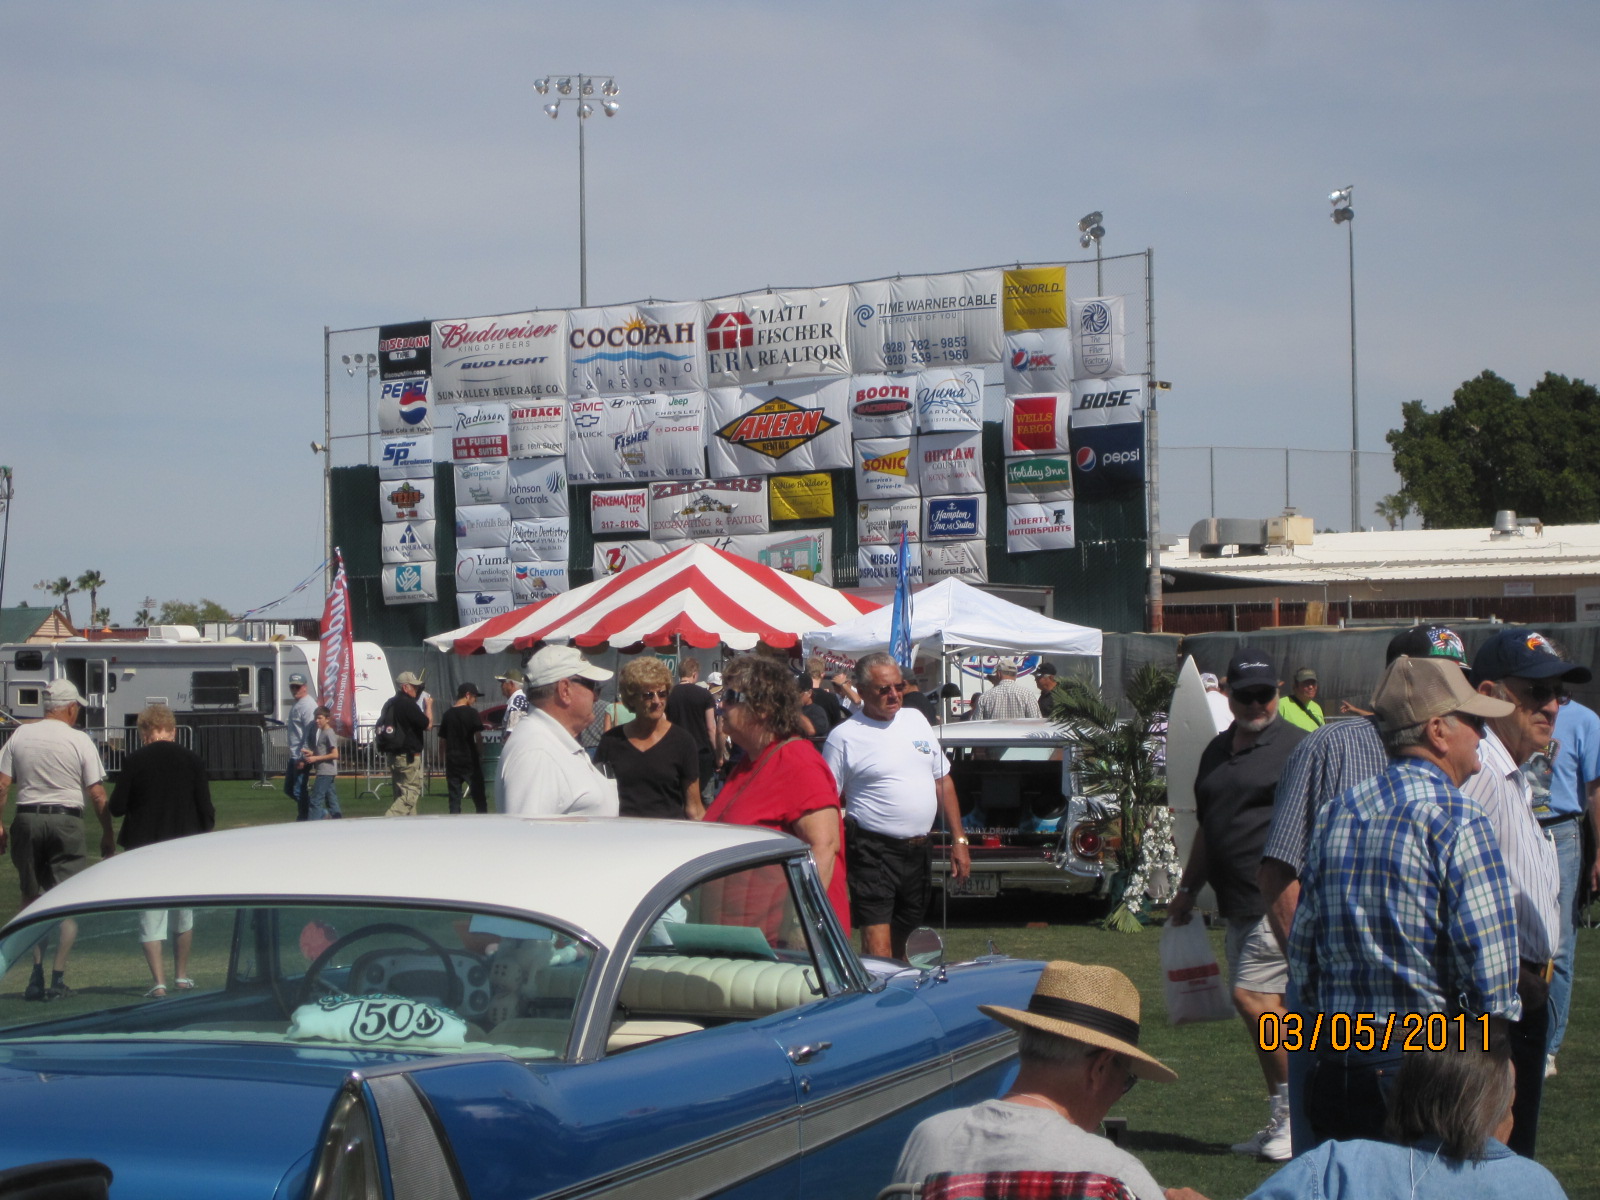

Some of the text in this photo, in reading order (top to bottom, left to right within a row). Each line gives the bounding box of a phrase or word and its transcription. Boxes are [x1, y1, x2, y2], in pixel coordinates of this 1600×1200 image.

[1022, 283, 1060, 294] WORLD
[877, 294, 997, 315] TIME WARNER CABLE
[758, 305, 808, 325] MATT
[894, 316, 923, 324] POWER
[440, 320, 558, 349] Budweiser
[569, 322, 695, 349] COCOPAH
[757, 323, 833, 346] FISCHER
[1090, 336, 1102, 344] The
[380, 335, 429, 351] DISCOUNT
[458, 341, 531, 353] KING OF BEERS
[883, 341, 906, 354] (928)
[758, 344, 842, 365] REALTOR
[883, 353, 907, 366] (928)
[1028, 353, 1057, 367] MAX
[1085, 357, 1109, 365] Factory
[460, 356, 549, 370] BUD LIGHT
[709, 352, 756, 374] ERA
[572, 362, 692, 378] CASINO
[381, 380, 429, 399] PEPSI
[586, 376, 678, 390] & RESORT
[437, 384, 559, 401] SUN VALLEY BEVERAGE CO
[856, 386, 910, 402] BOOTH
[669, 397, 689, 407] Jeep
[1073, 389, 1140, 410] BOSE
[511, 407, 561, 419] OUTBACK
[572, 402, 604, 412] GMC
[456, 408, 505, 431] Radisson
[1016, 412, 1053, 424] WELLS
[729, 410, 823, 443] AHERN
[1017, 424, 1052, 434] FARGO
[456, 436, 502, 447] LA FUENTE
[577, 431, 603, 439] BUICK
[614, 431, 649, 451] FISHER
[456, 449, 468, 457] INN
[470, 448, 476, 456] &
[478, 447, 502, 456] SUITES
[762, 441, 790, 451] RENTALS
[924, 446, 976, 463] OUTLAW
[1103, 448, 1140, 466] pepsi
[863, 456, 907, 472] SONIC
[1009, 465, 1066, 480] Holiday Inn
[509, 485, 542, 495] Johnson
[653, 478, 763, 500] ZELLERS
[515, 495, 549, 505] Controls
[592, 492, 645, 511] FENCEMASTERS
[931, 509, 971, 521] Hampton
[1014, 516, 1050, 526] LIBERTY
[601, 520, 640, 529] 317-8106
[654, 514, 763, 530] EXCAVATING & PAVING
[930, 521, 947, 531] Inn
[952, 520, 975, 529] Suites
[540, 525, 569, 539] Dentistry
[1008, 525, 1072, 536] MOTORSPORTS
[476, 555, 509, 565] Yuma
[871, 554, 899, 565] MISSIO
[476, 568, 509, 577] Cardiology
[529, 567, 565, 577] Chevron
[928, 566, 980, 576] National Bank
[460, 606, 510, 616] HOMEWOOD
[989, 827, 1019, 835] DRIVER
[360, 1001, 437, 1036] 50s
